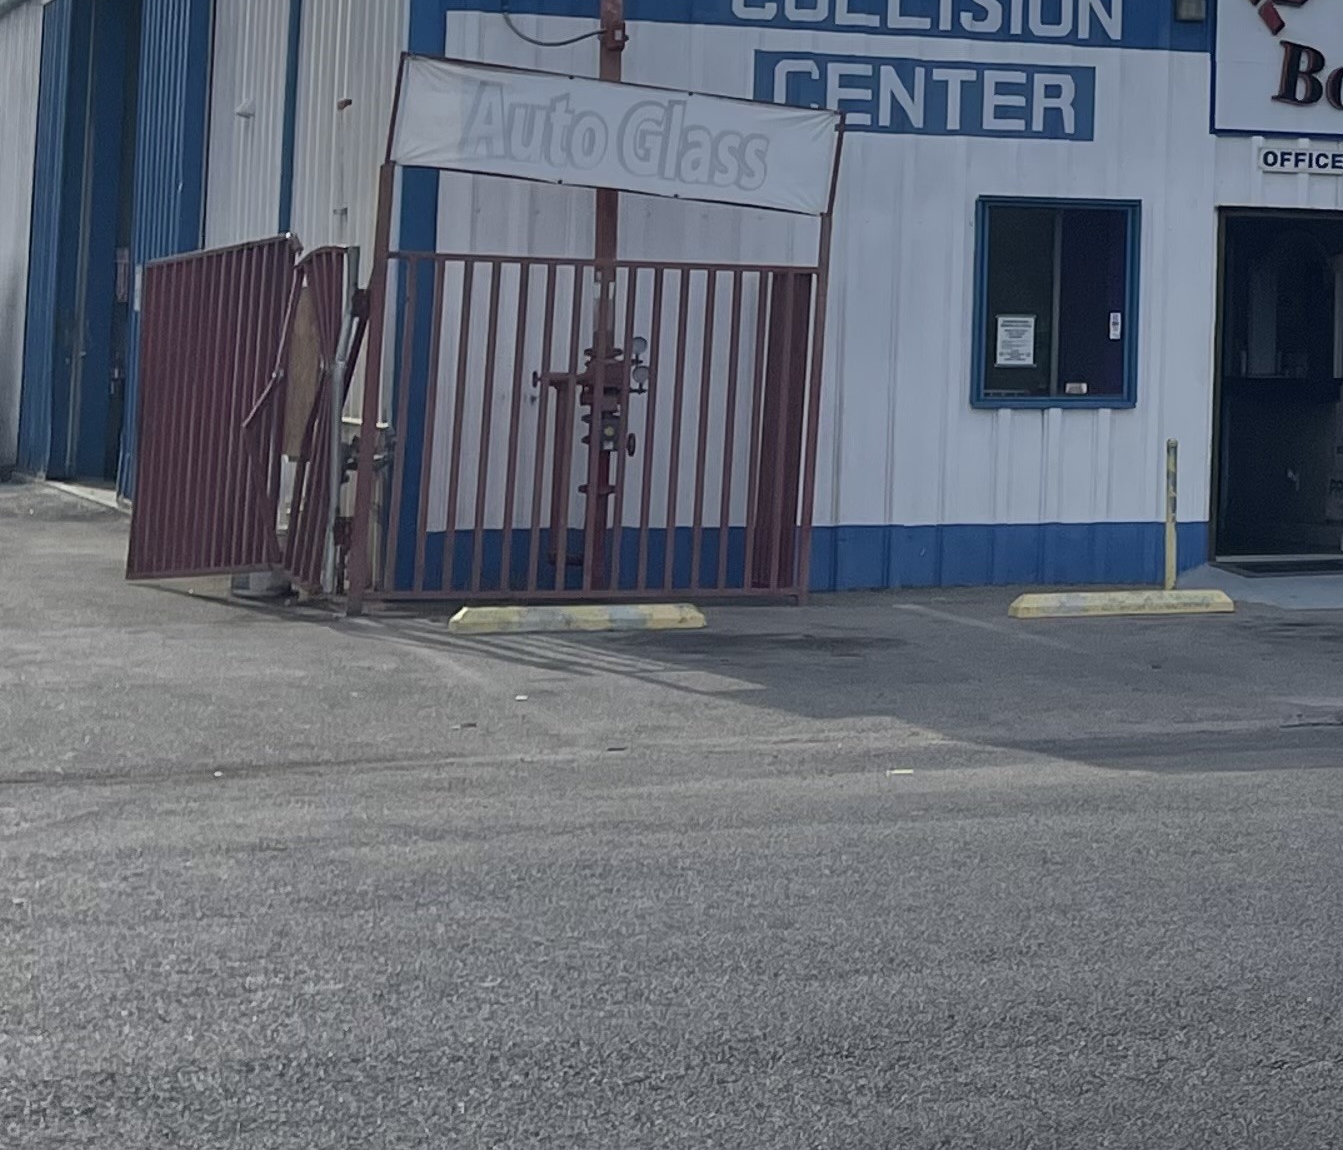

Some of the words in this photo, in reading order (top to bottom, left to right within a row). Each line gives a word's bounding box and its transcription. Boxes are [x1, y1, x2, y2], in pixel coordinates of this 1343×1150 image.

[458, 79, 609, 171] Auto
[616, 98, 770, 191] Glass
[773, 58, 1077, 136] CENTER
